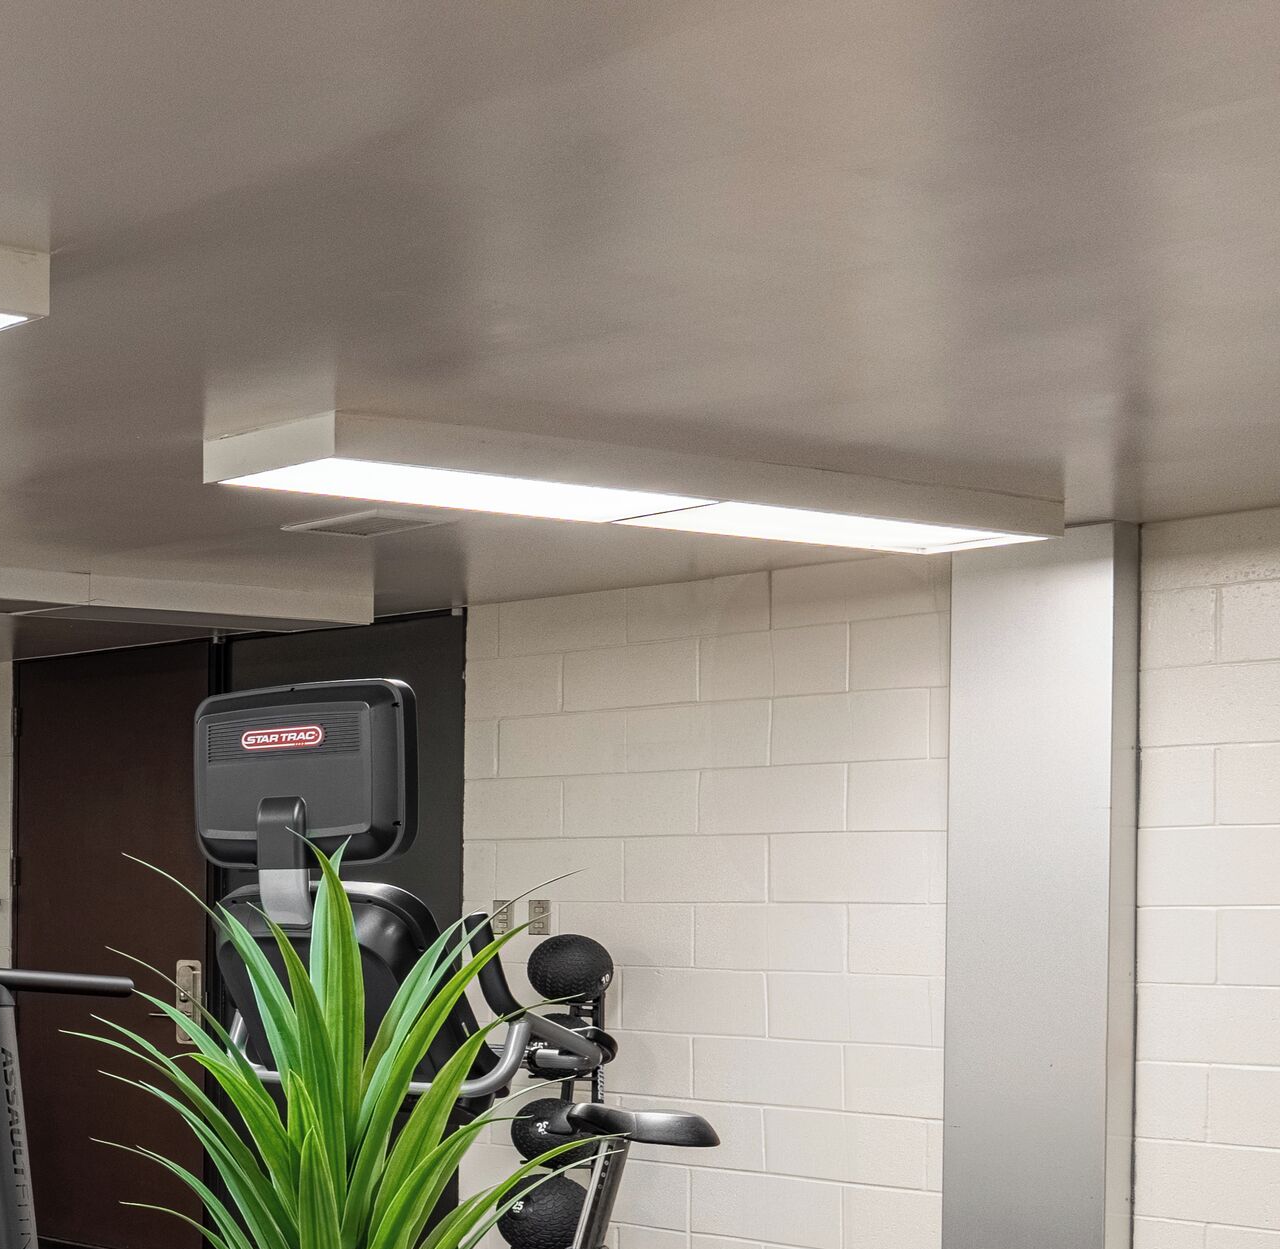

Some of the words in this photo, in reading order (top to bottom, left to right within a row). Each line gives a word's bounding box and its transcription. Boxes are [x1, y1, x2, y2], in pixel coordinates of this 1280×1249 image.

[245, 733, 278, 744] STAR
[280, 731, 316, 742] TRAC
[0, 1047, 25, 1176] ASSAULT
